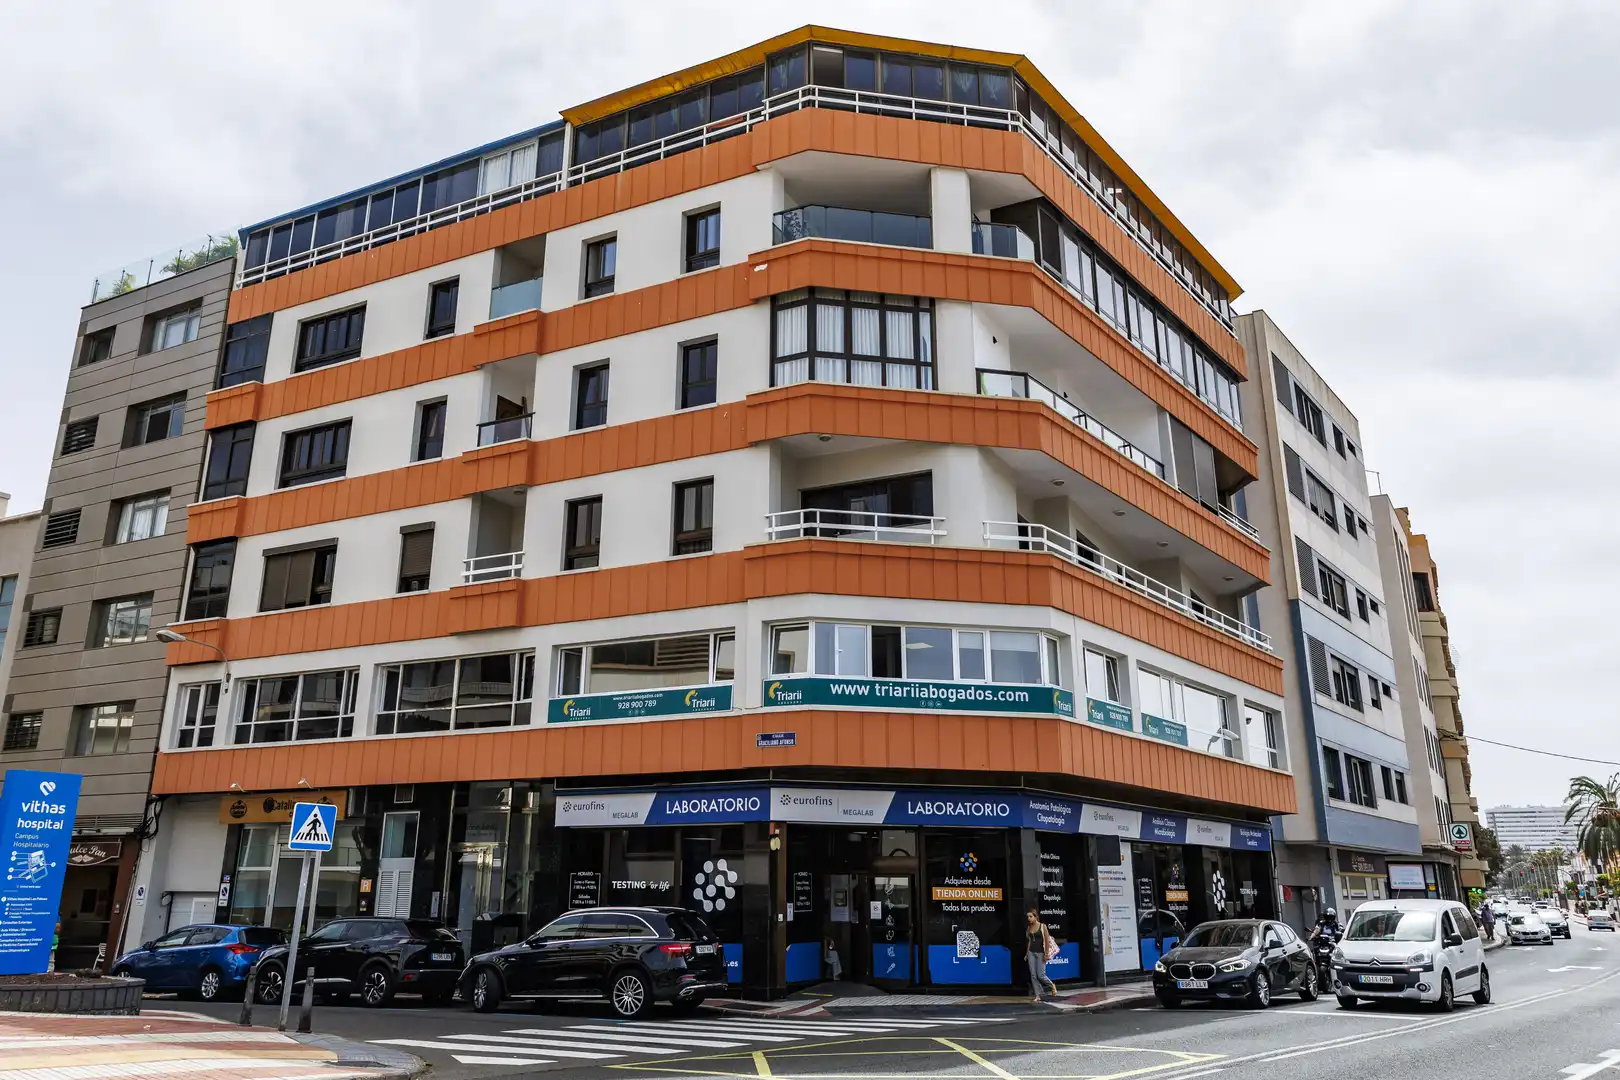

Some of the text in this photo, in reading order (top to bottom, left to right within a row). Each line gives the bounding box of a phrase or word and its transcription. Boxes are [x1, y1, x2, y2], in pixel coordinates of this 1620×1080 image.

[776, 690, 802, 701] Triarii
[618, 701, 630, 710] 928
[692, 698, 715, 708] Triarii
[569, 707, 591, 717] Triarii
[666, 797, 760, 814] LABORATORIO
[793, 796, 833, 806] eurofins
[22, 800, 66, 814] vithas
[573, 802, 605, 811] eurofins
[908, 801, 1009, 817] LABORATORIO
[17, 818, 64, 830] hospital
[70, 843, 106, 857] ulce Pan
[612, 881, 646, 889] TESTING
[659, 881, 670, 891] life
[944, 876, 991, 886] Adquiere desde
[936, 890, 999, 898] TIENDA ONLINE
[942, 902, 995, 914] Todas las pruebas
